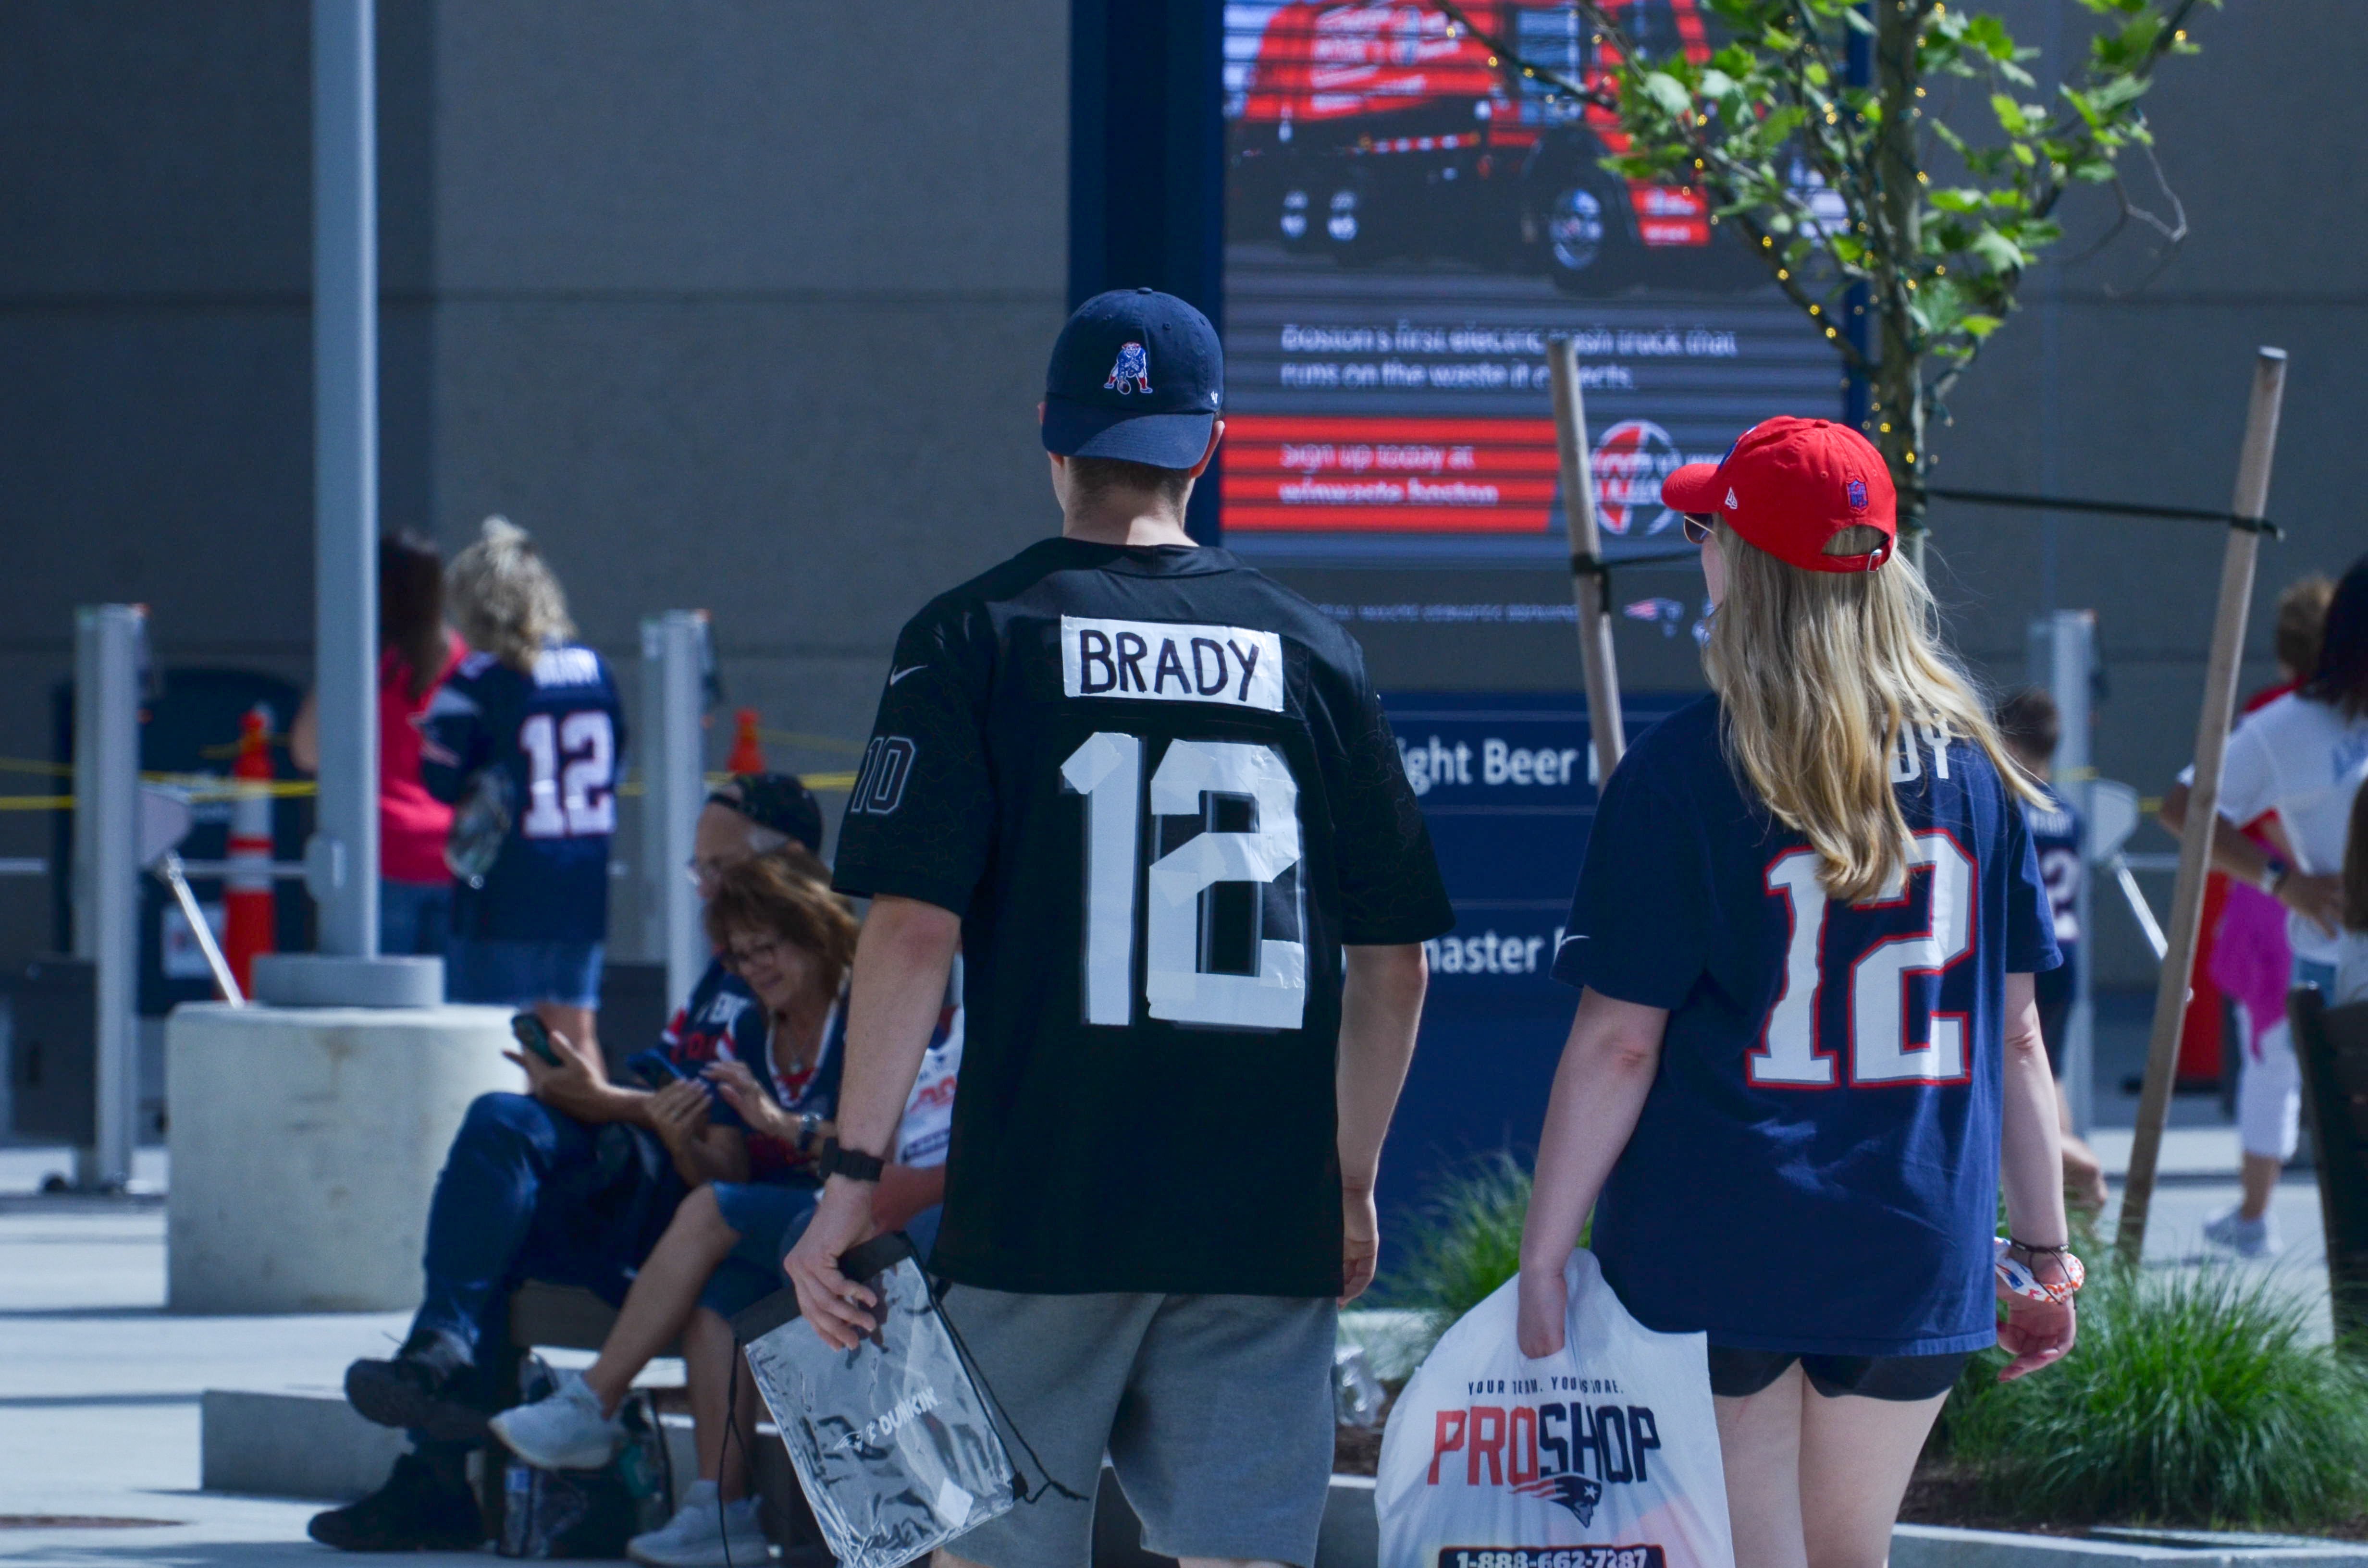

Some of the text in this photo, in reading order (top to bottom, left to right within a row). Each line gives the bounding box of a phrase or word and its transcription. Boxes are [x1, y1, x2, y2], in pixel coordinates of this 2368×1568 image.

[1549, 324, 1614, 355] ash
[1080, 629, 1259, 702] BRADY
[518, 711, 617, 838] 12
[850, 736, 916, 814] 10
[1483, 737, 1579, 785] Beer
[1060, 731, 1305, 1030] 12
[1745, 827, 1979, 1089] 12
[1468, 1380, 1505, 1396] YOUR
[1581, 1379, 1624, 1394] SORE.
[1456, 1549, 1647, 1568] 1-888-662-7287
